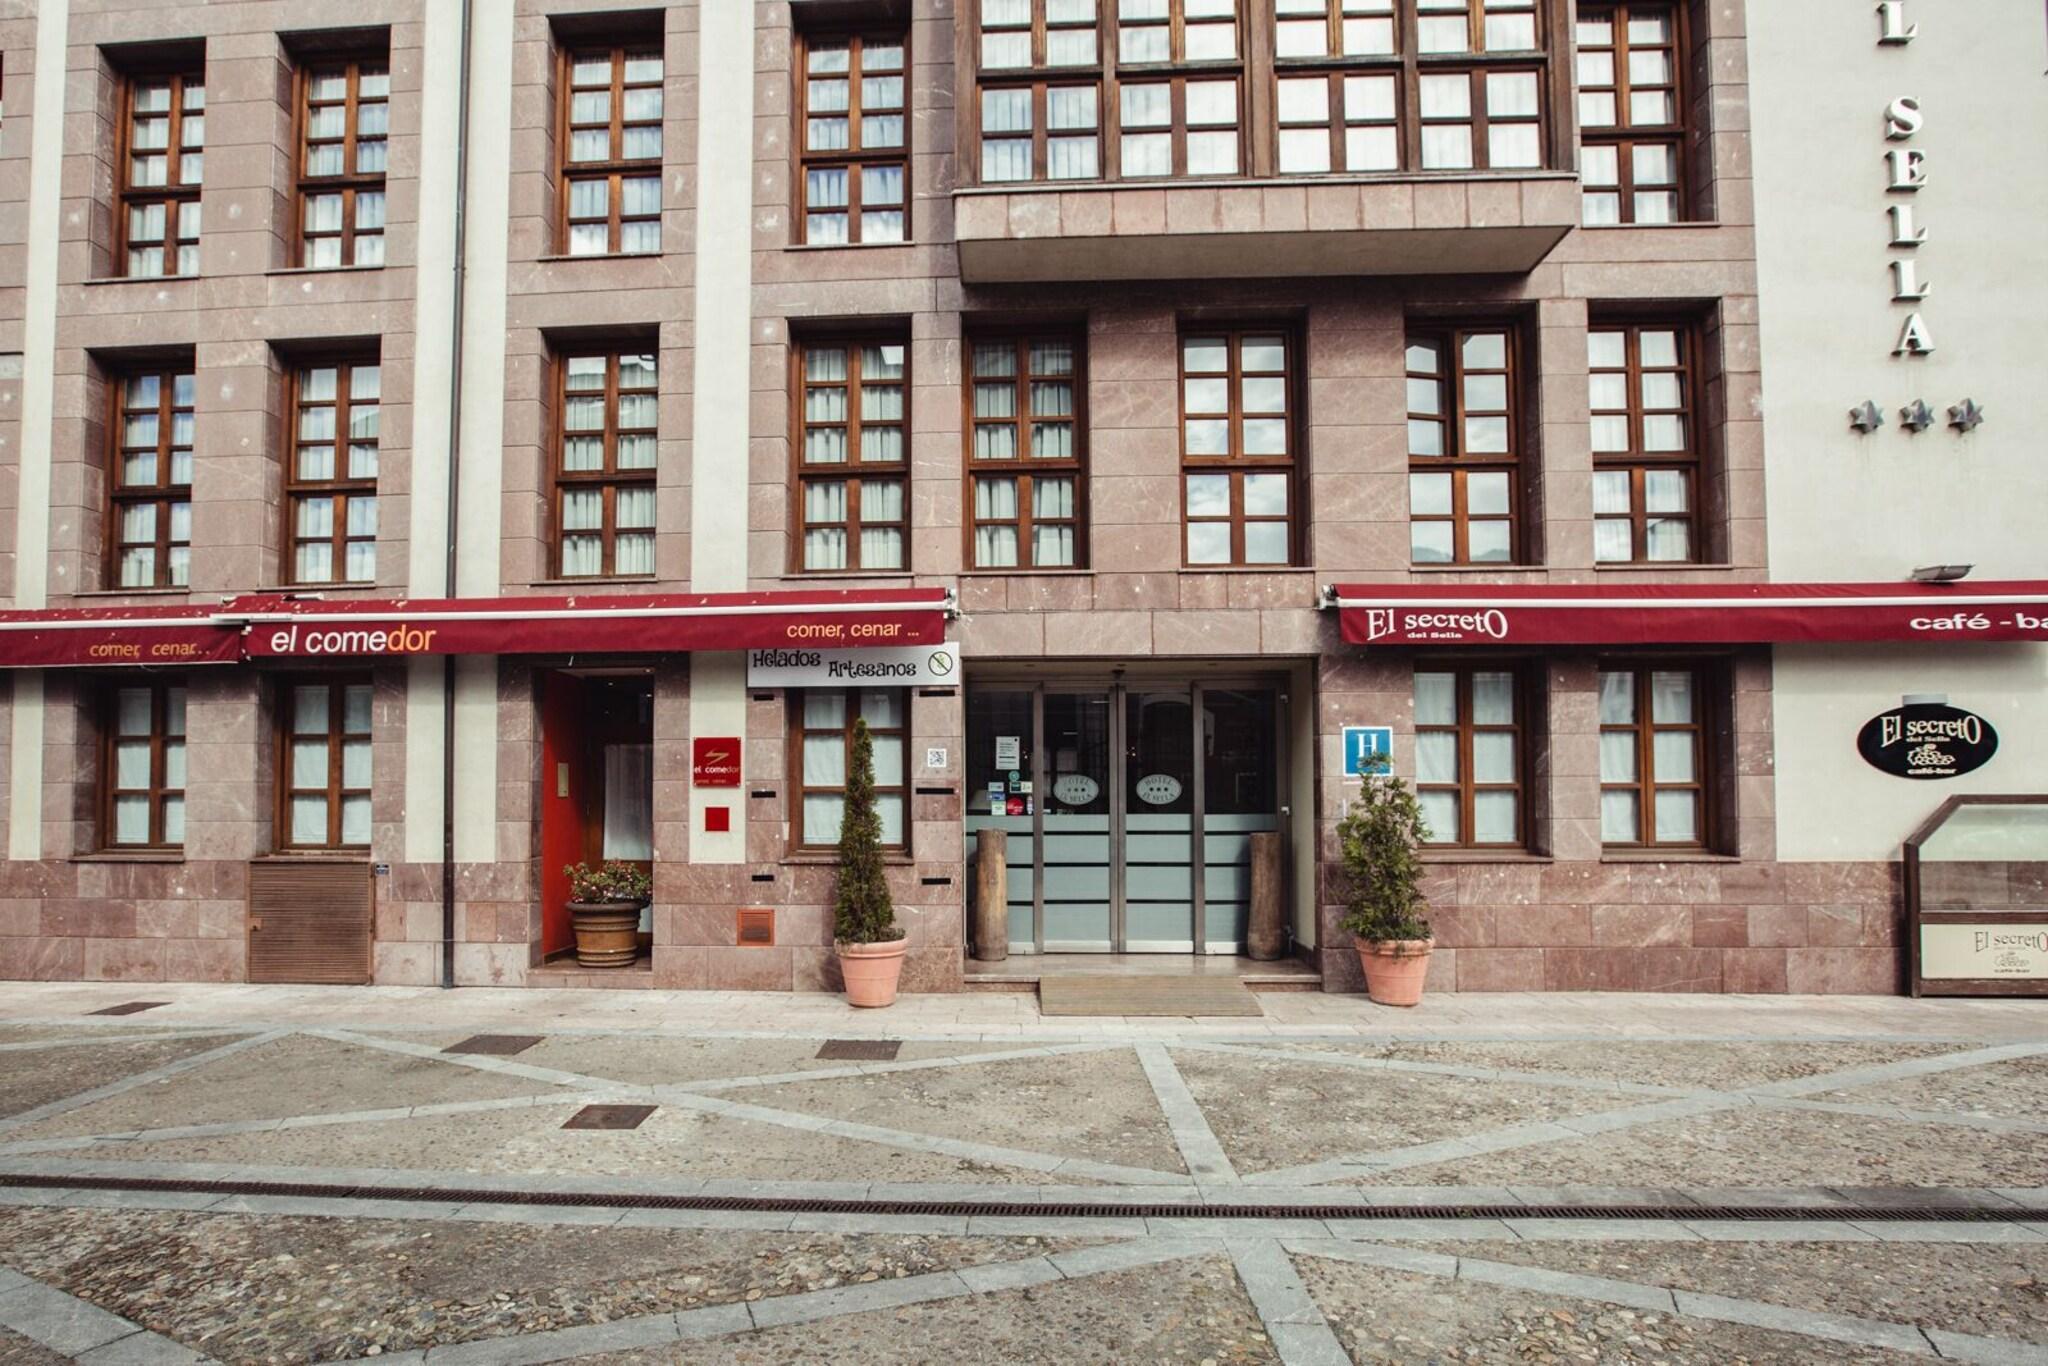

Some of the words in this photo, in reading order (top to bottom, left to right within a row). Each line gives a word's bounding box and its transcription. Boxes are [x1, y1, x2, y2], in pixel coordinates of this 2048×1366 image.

[1883, 96, 1936, 356] SELLA
[786, 624, 846, 639] comer,
[850, 623, 902, 638] cenar
[1365, 608, 1396, 641] El
[1404, 609, 1508, 639] secretO
[1407, 631, 1427, 639] del
[1430, 631, 1462, 639] Sella
[1910, 613, 1991, 630] café
[270, 625, 298, 652] el
[305, 624, 437, 653] comedor
[753, 650, 821, 668] Helados
[828, 660, 917, 679] Artesanos
[1880, 715, 1902, 748] El
[1906, 715, 1982, 745] secretO
[1975, 931, 1989, 952] El
